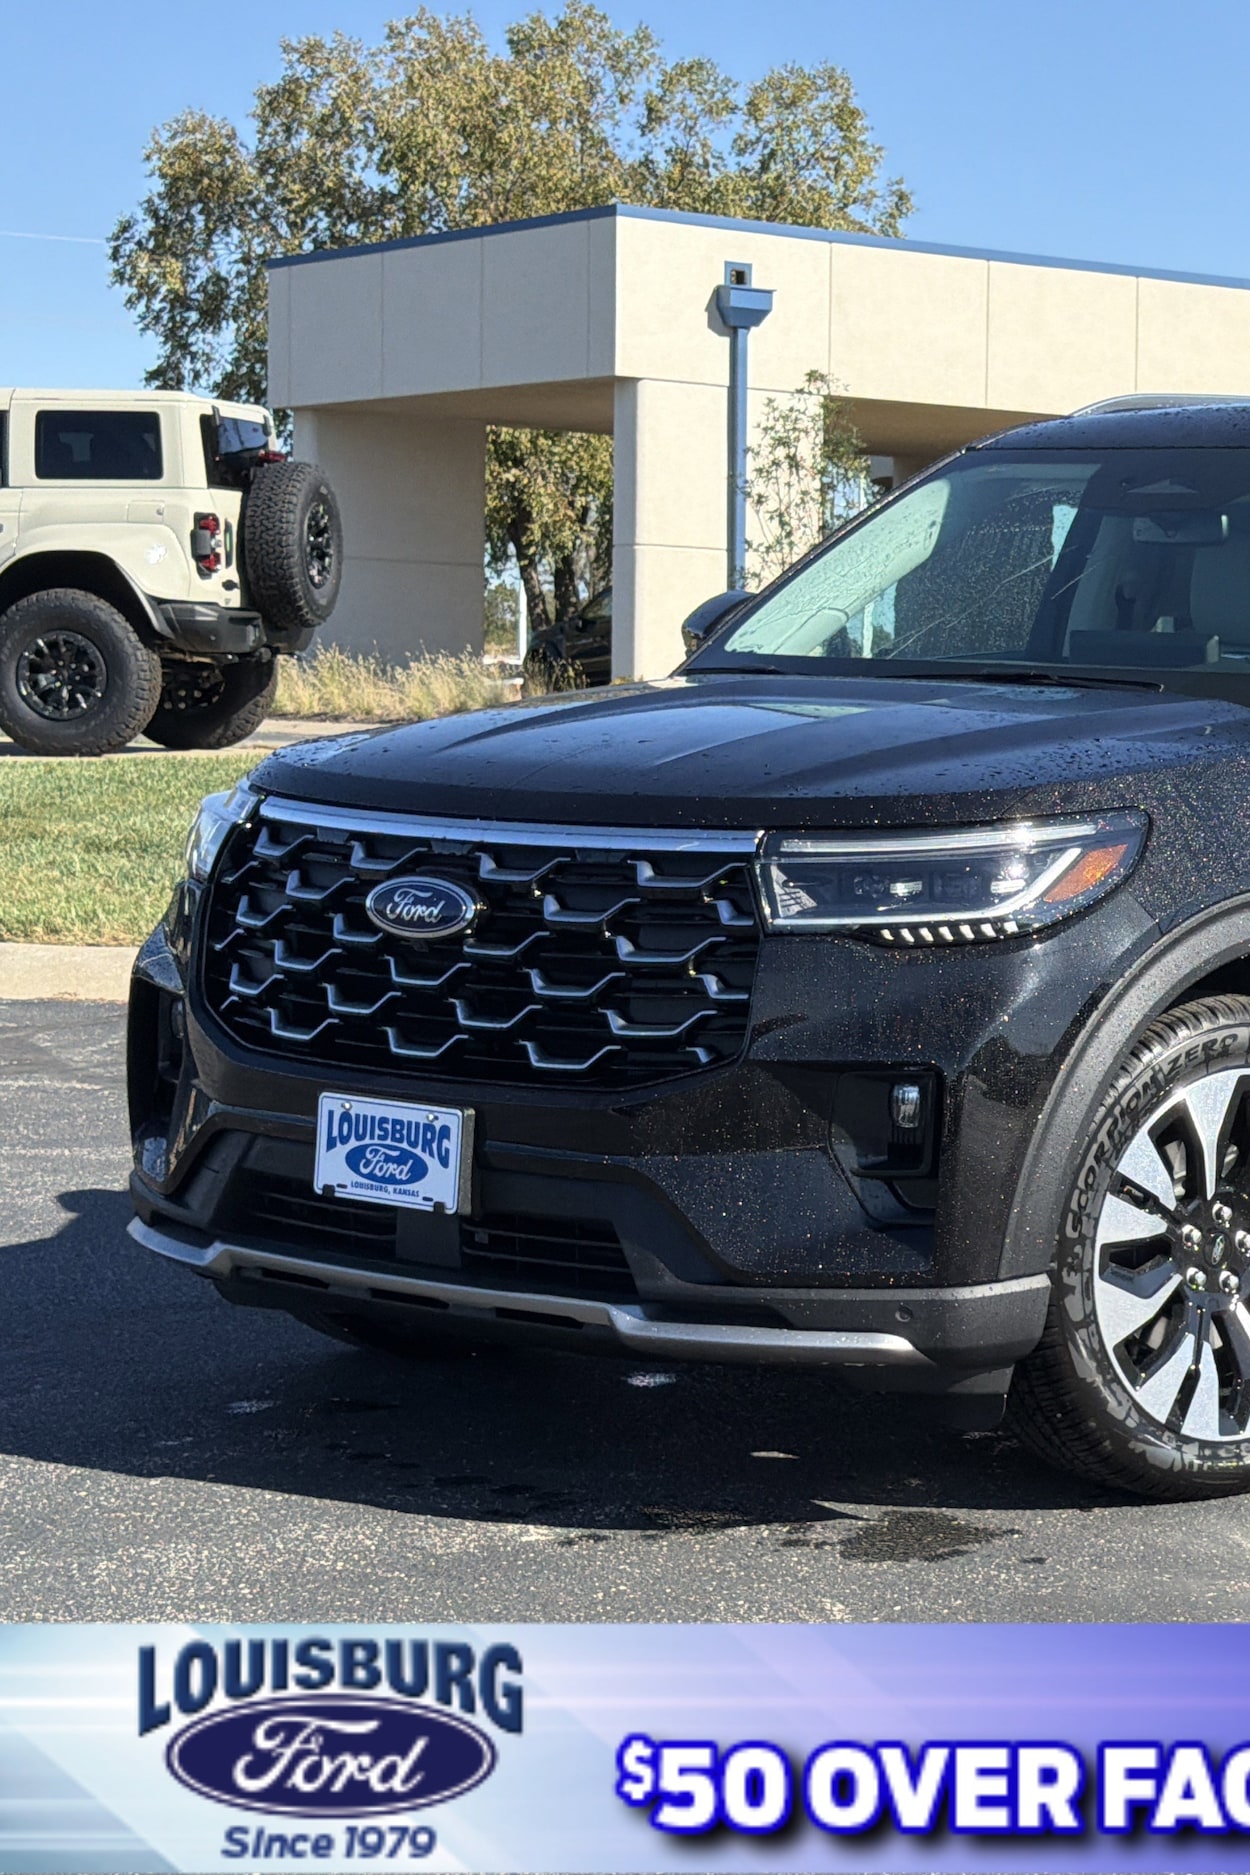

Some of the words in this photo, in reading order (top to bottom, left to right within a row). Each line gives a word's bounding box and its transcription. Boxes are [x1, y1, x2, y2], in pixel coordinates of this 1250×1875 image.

[386, 888, 445, 922] Ford
[1166, 1032, 1239, 1078] ZERO
[326, 1109, 452, 1169] LOUISBURG
[359, 1145, 412, 1181] Ford
[350, 1180, 392, 1195] LOUISBURG,
[392, 1185, 420, 1198] KANSAS
